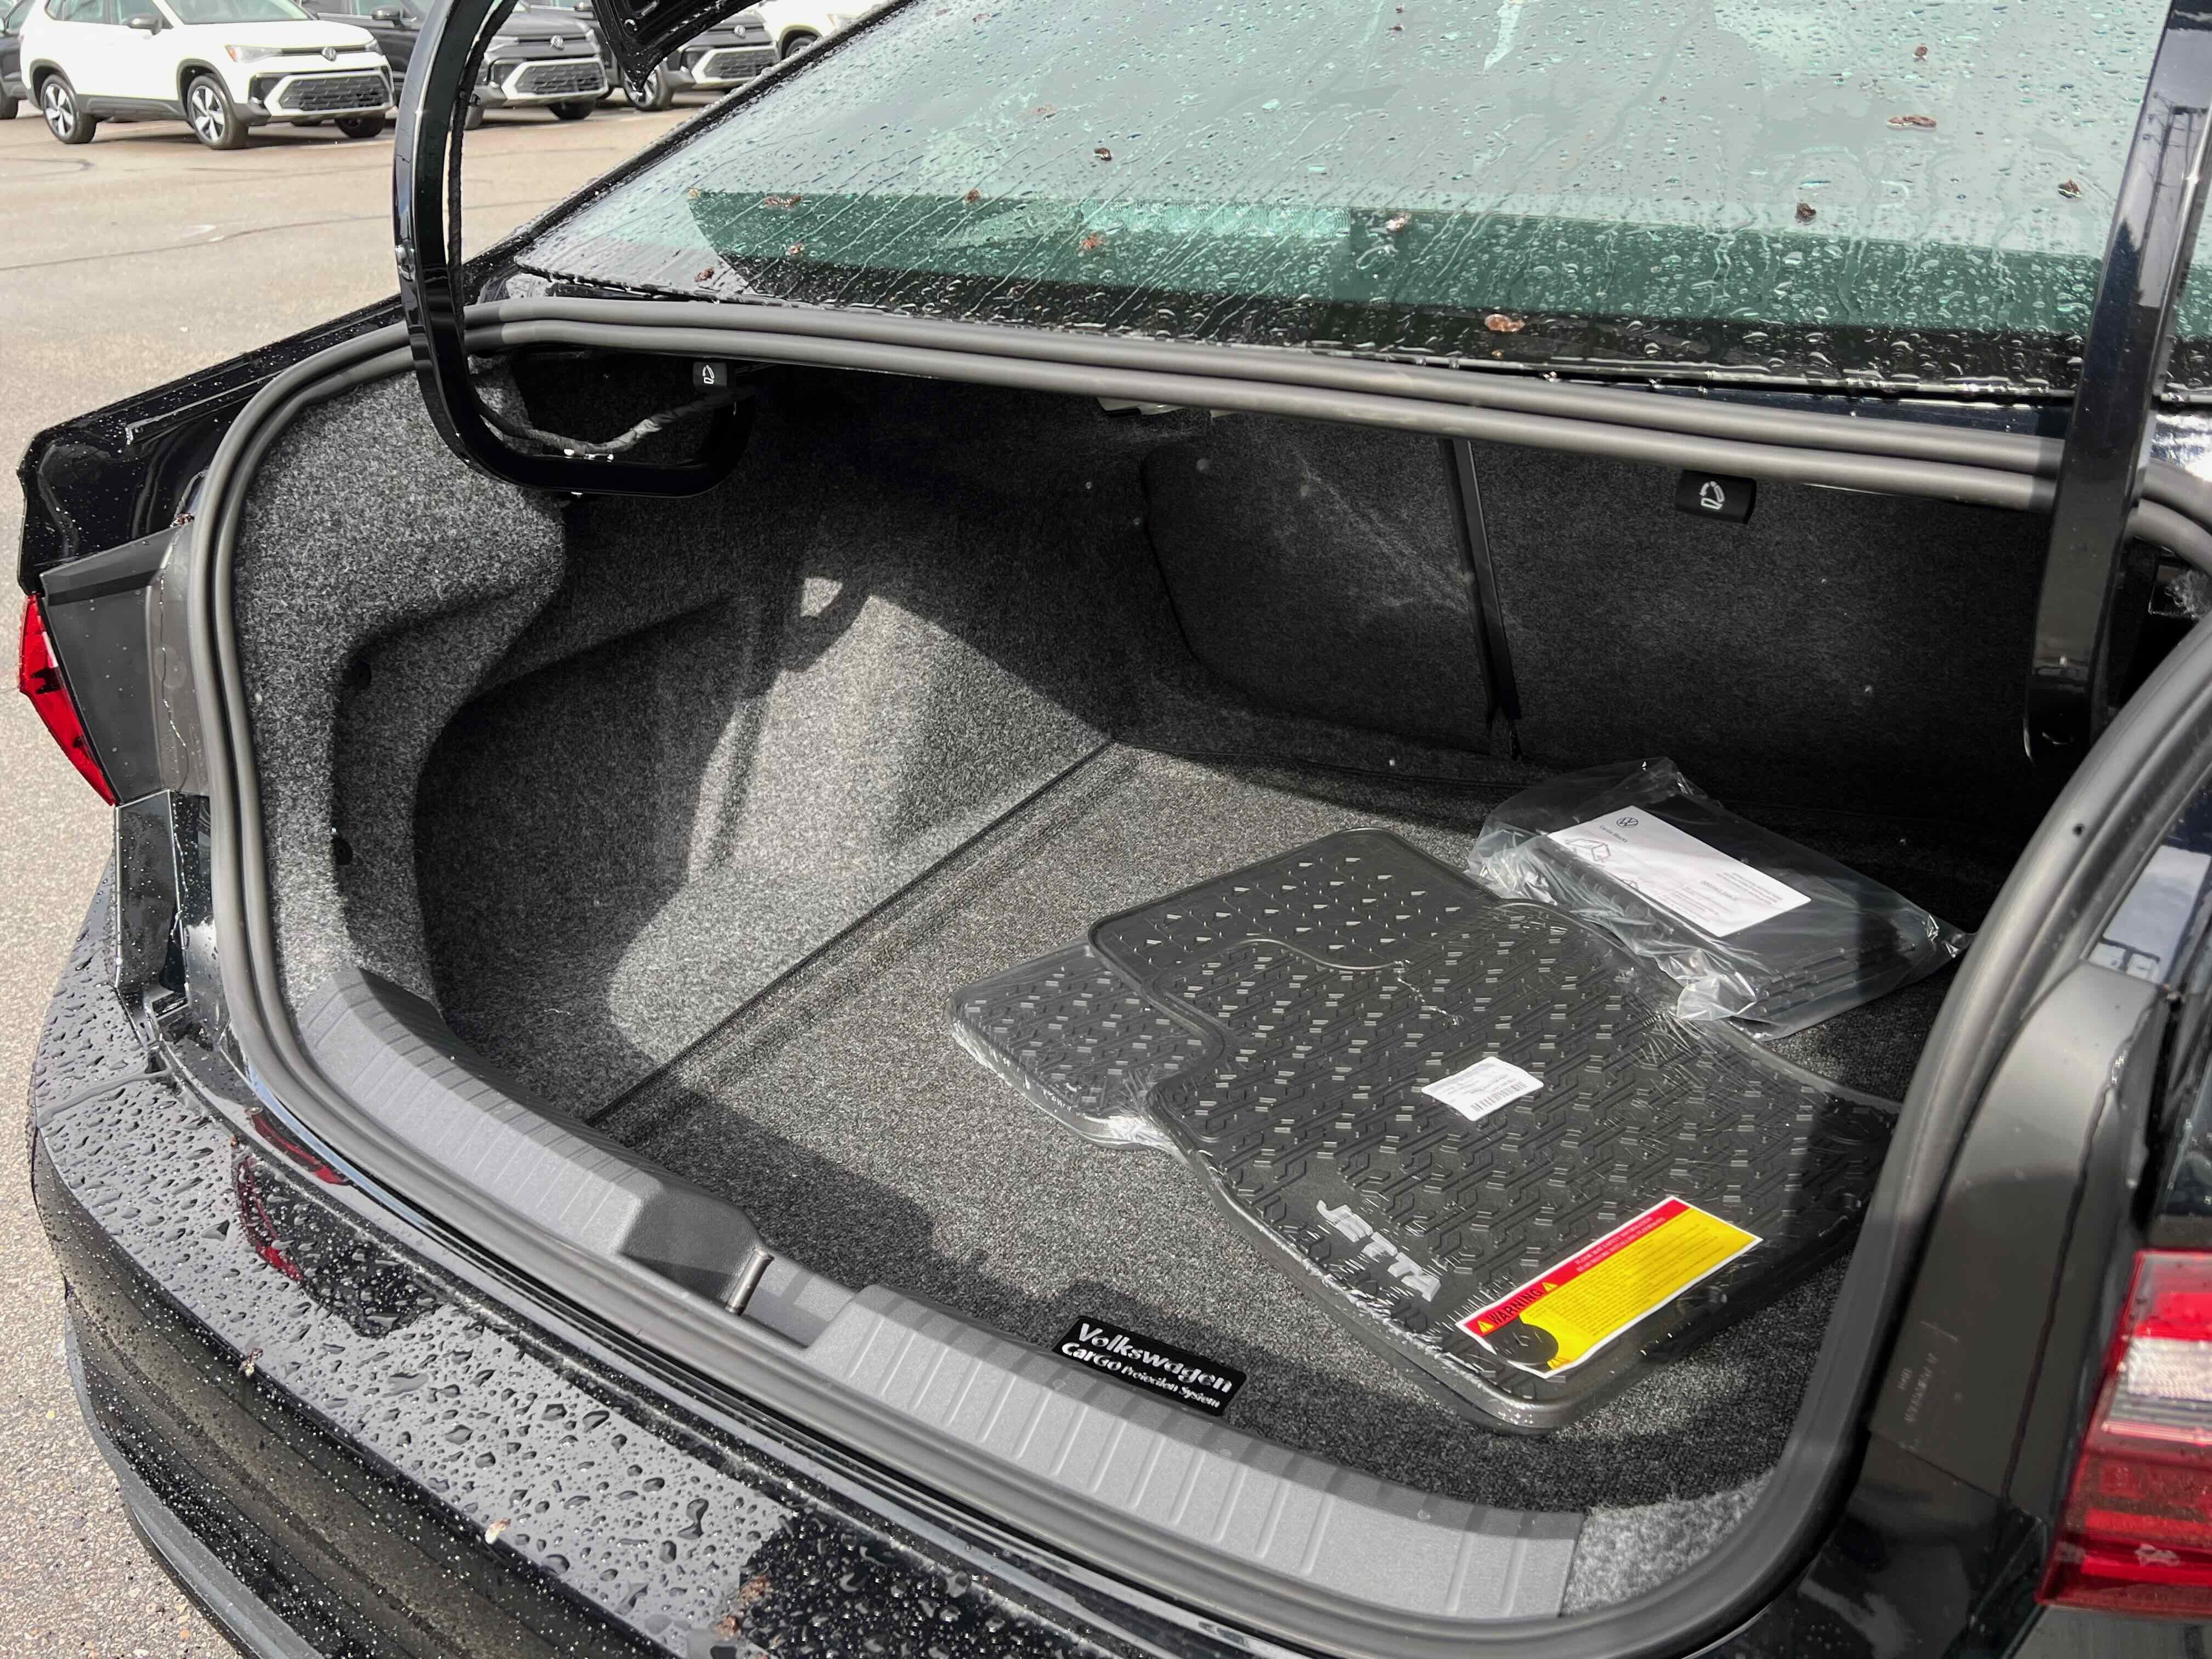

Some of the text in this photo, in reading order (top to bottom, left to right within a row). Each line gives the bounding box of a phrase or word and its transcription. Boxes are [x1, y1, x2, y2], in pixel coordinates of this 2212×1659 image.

[1317, 1199, 1441, 1302] JETTA
[1488, 1289, 1545, 1325] WARNING
[1078, 1323, 1232, 1393] Volkswagen
